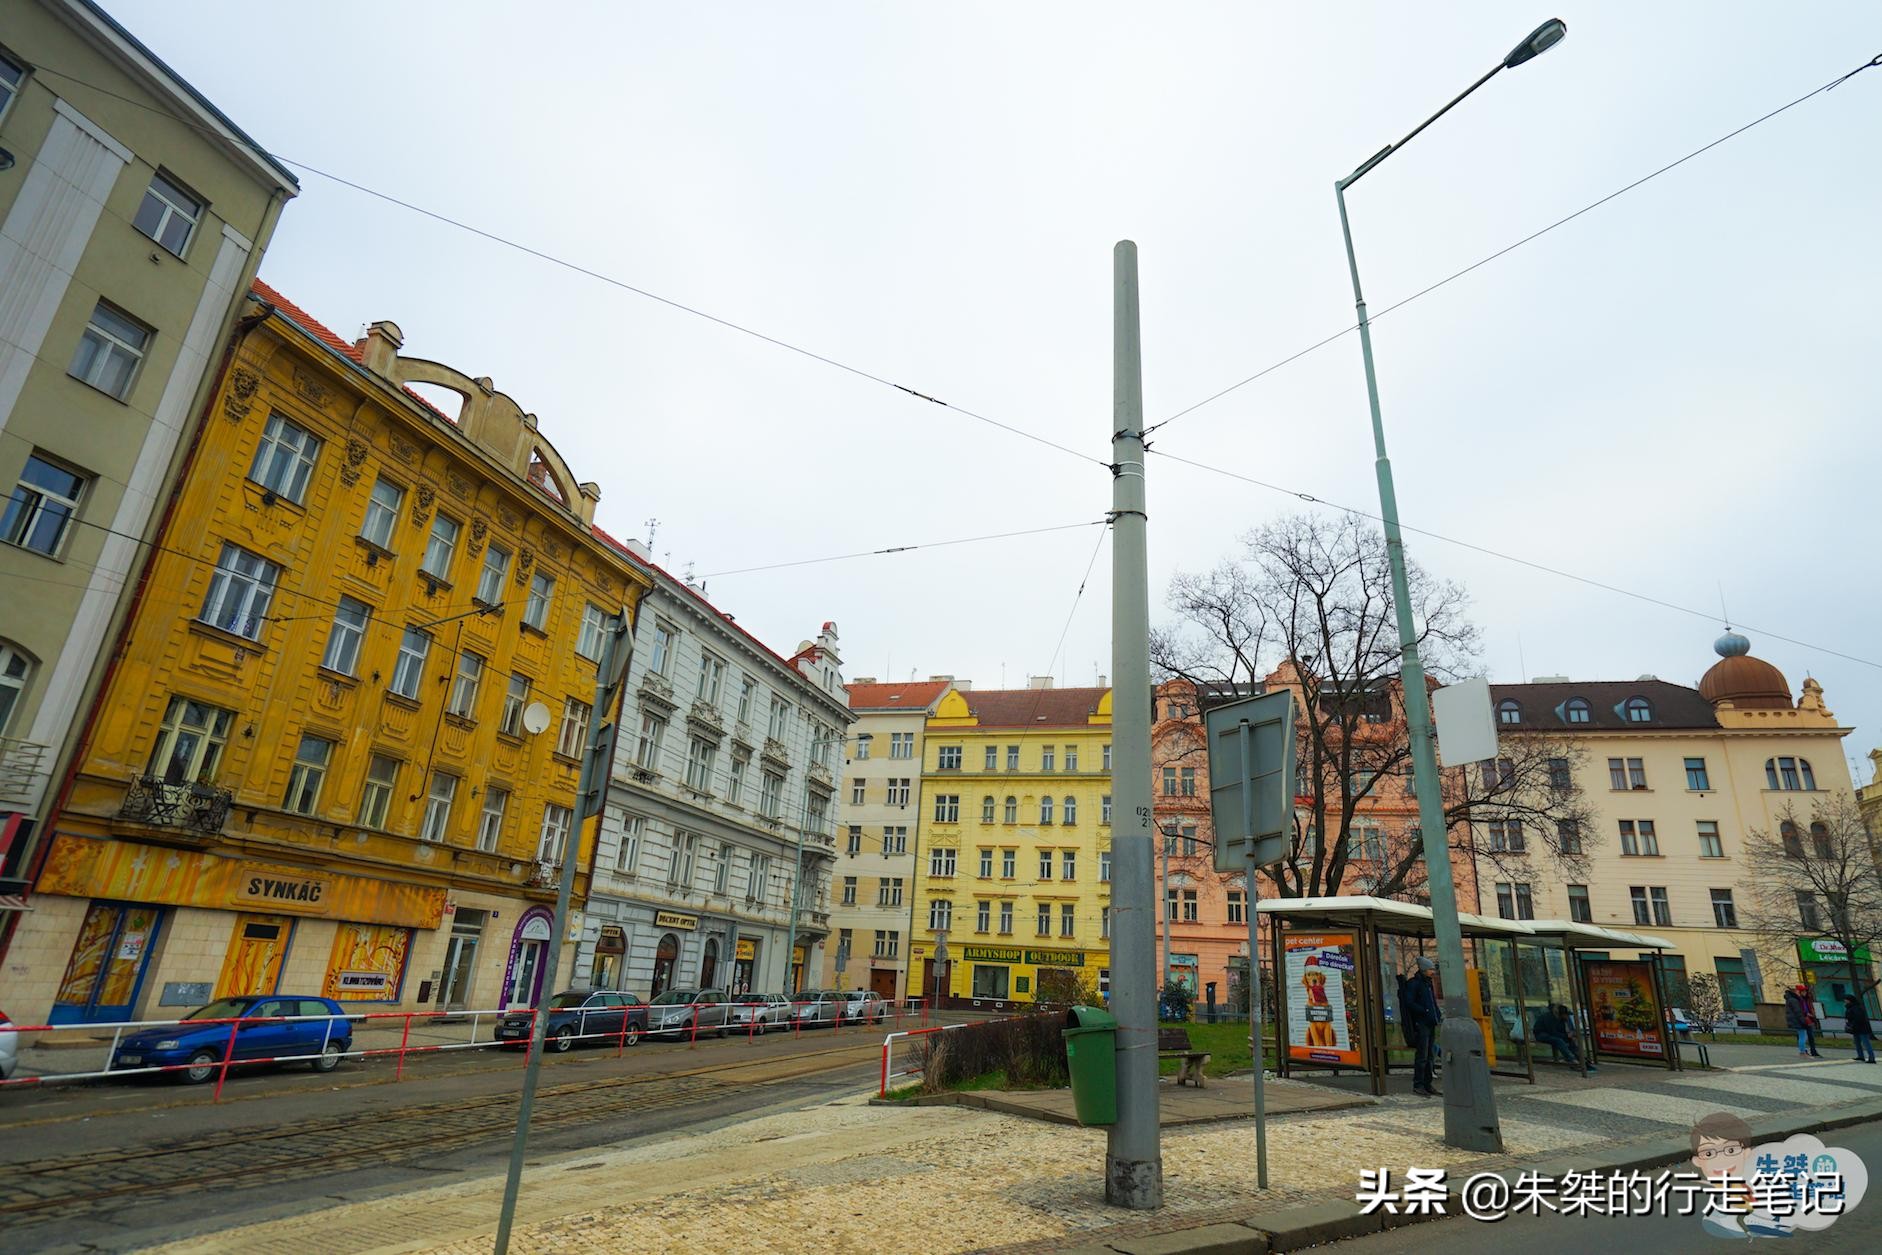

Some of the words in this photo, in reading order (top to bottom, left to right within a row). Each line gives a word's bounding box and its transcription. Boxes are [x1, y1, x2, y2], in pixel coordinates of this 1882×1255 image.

[248, 878, 321, 902] SYNKÁČ
[1285, 937, 1298, 945] pet
[1298, 937, 1324, 945] center
[966, 948, 1021, 961] ARMYSHOP
